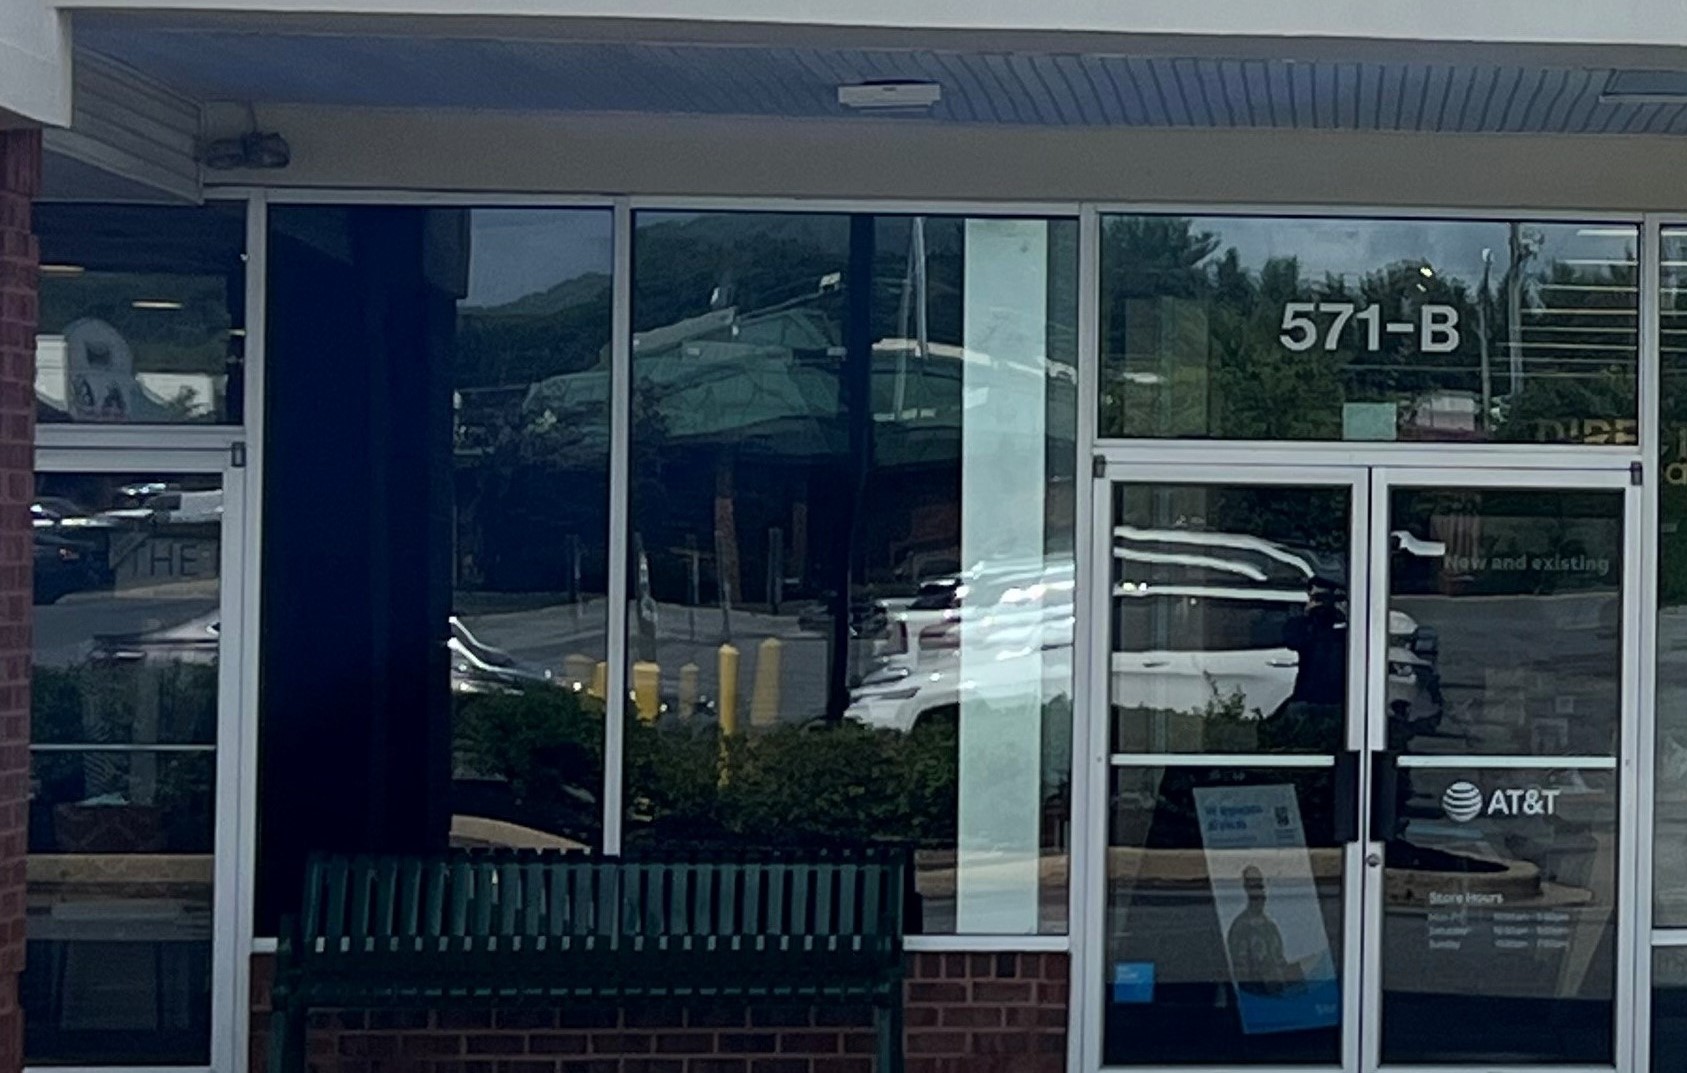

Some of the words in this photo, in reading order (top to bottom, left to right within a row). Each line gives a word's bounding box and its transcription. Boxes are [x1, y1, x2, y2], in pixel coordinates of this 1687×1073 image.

[1279, 302, 1460, 353] 571-B
[1491, 553, 1527, 570] and
[1531, 553, 1609, 576] existing
[1487, 788, 1560, 815] AT&T
